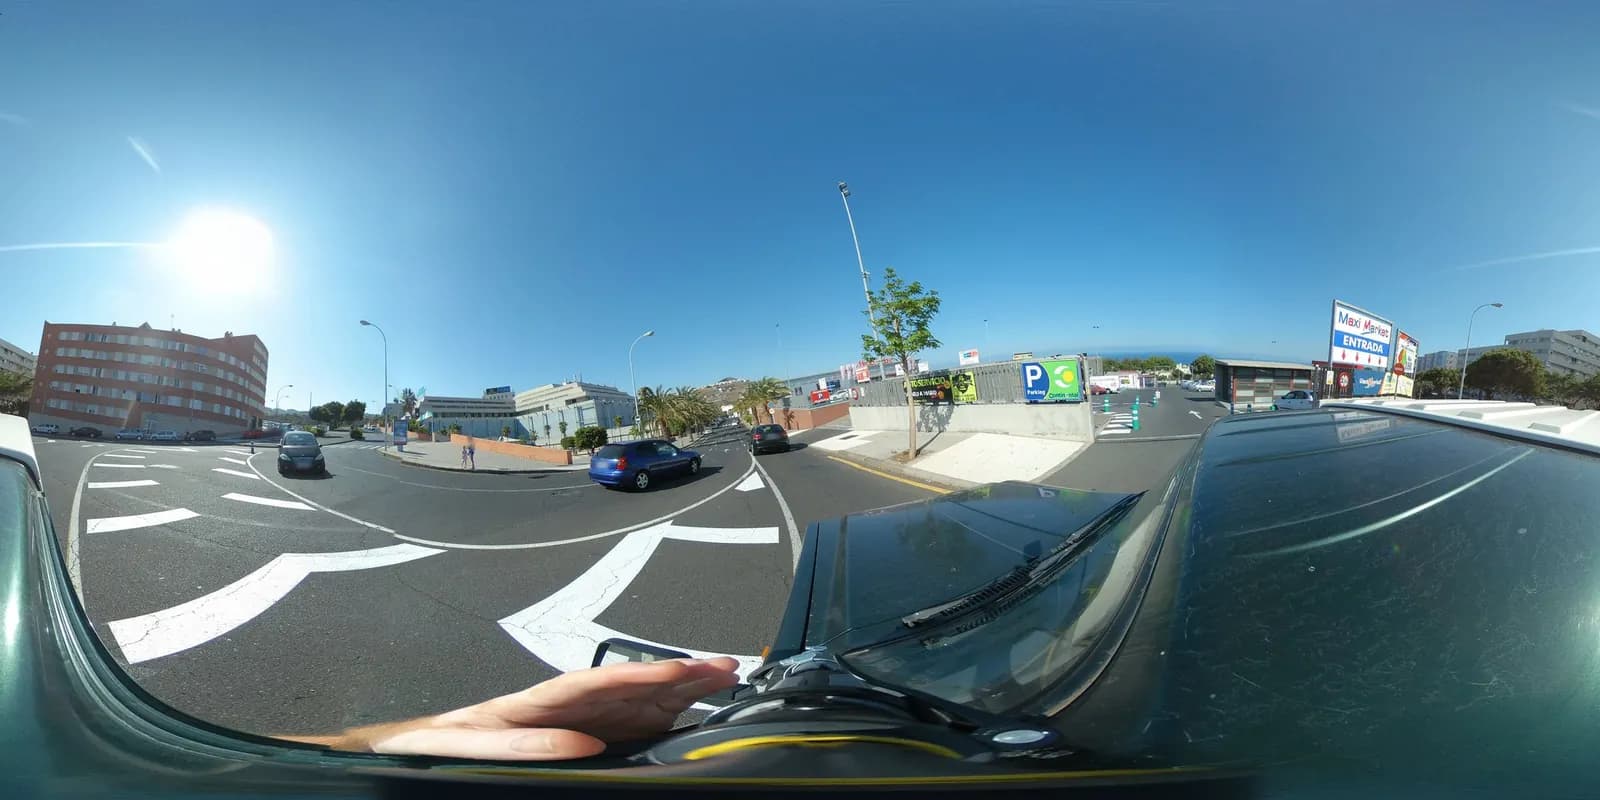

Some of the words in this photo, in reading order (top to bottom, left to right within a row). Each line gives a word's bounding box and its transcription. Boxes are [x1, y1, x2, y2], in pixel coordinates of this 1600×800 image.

[1338, 311, 1361, 328] Maxi
[1363, 319, 1389, 338] Market
[1343, 334, 1384, 354] ENTRADA
[1025, 365, 1042, 388] P
